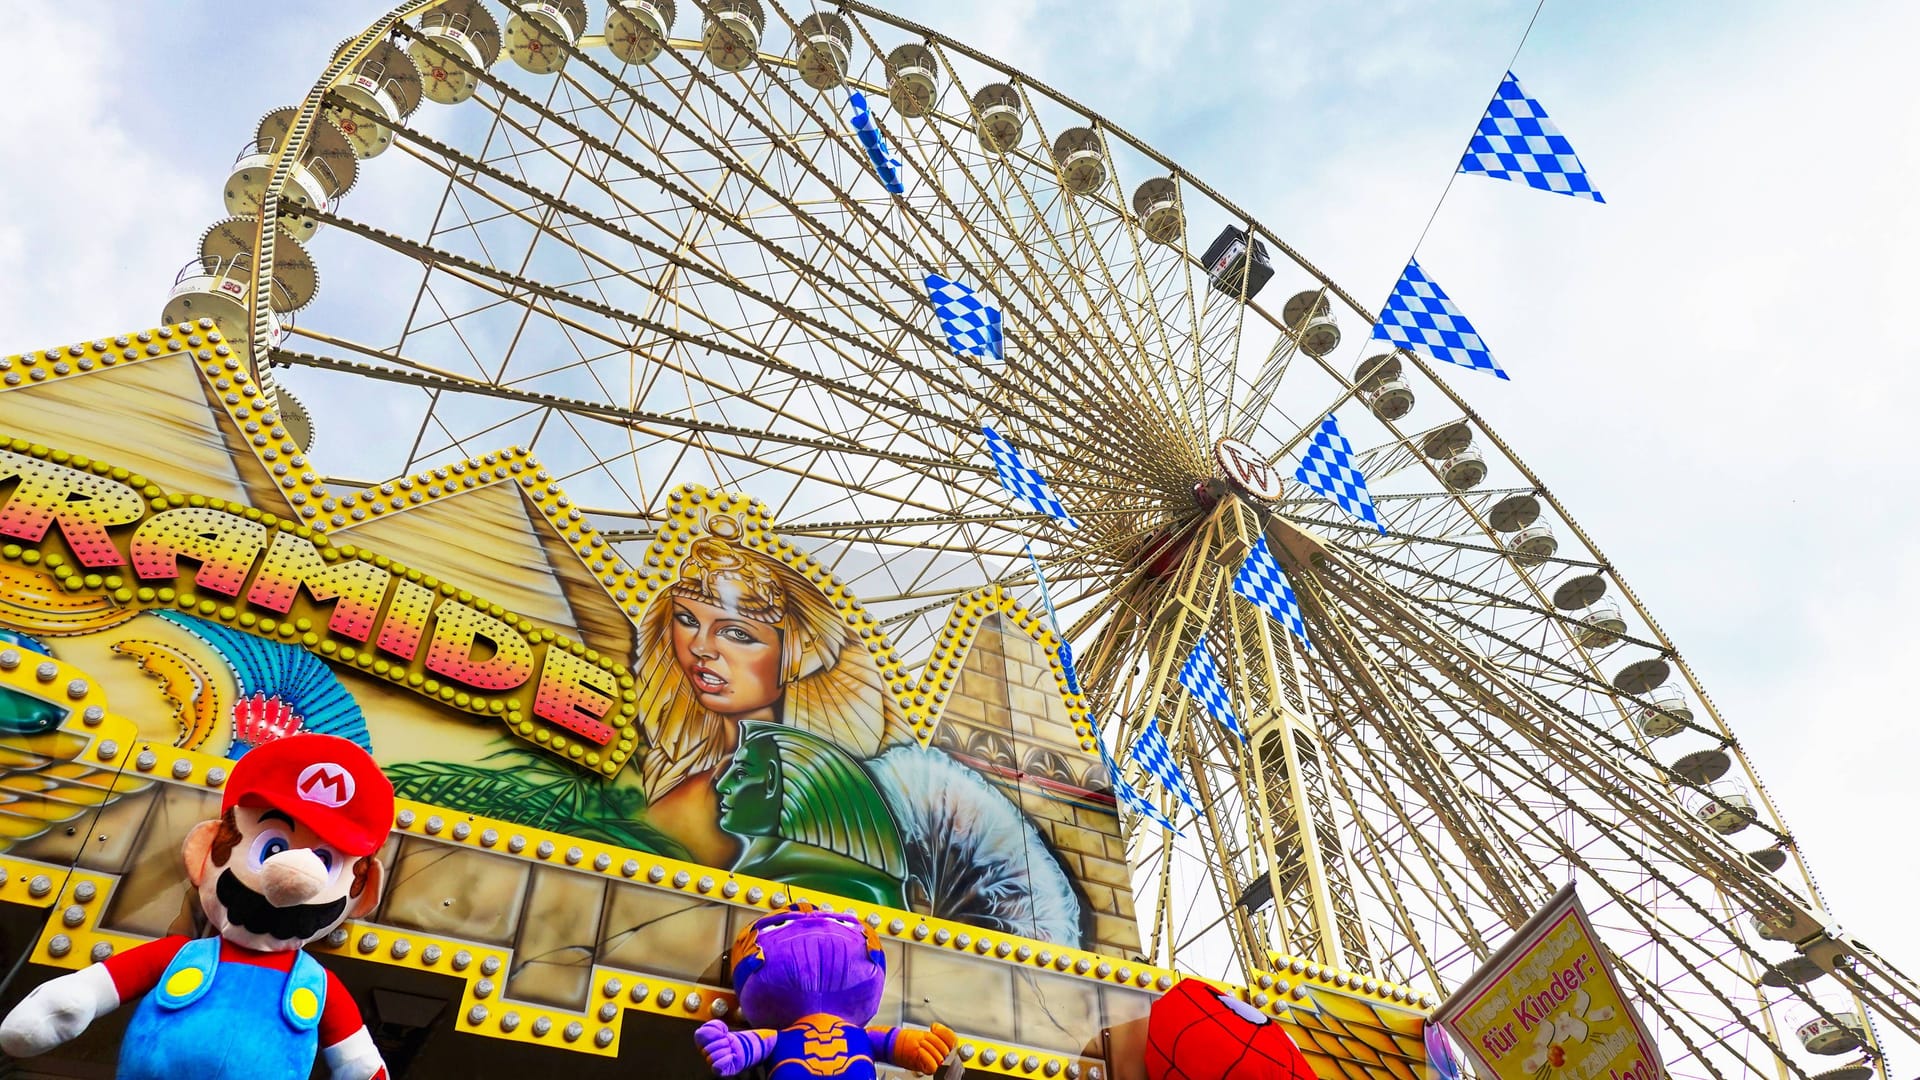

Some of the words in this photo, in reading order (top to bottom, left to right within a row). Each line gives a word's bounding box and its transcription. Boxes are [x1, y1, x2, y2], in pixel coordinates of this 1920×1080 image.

[1222, 443, 1268, 491] W
[300, 768, 347, 802] M
[1457, 988, 1512, 1038] Unser
[1508, 920, 1581, 997] Angebot
[1482, 1022, 1519, 1061] für
[1512, 953, 1597, 1032] Kinder:
[1807, 1023, 1819, 1035] W
